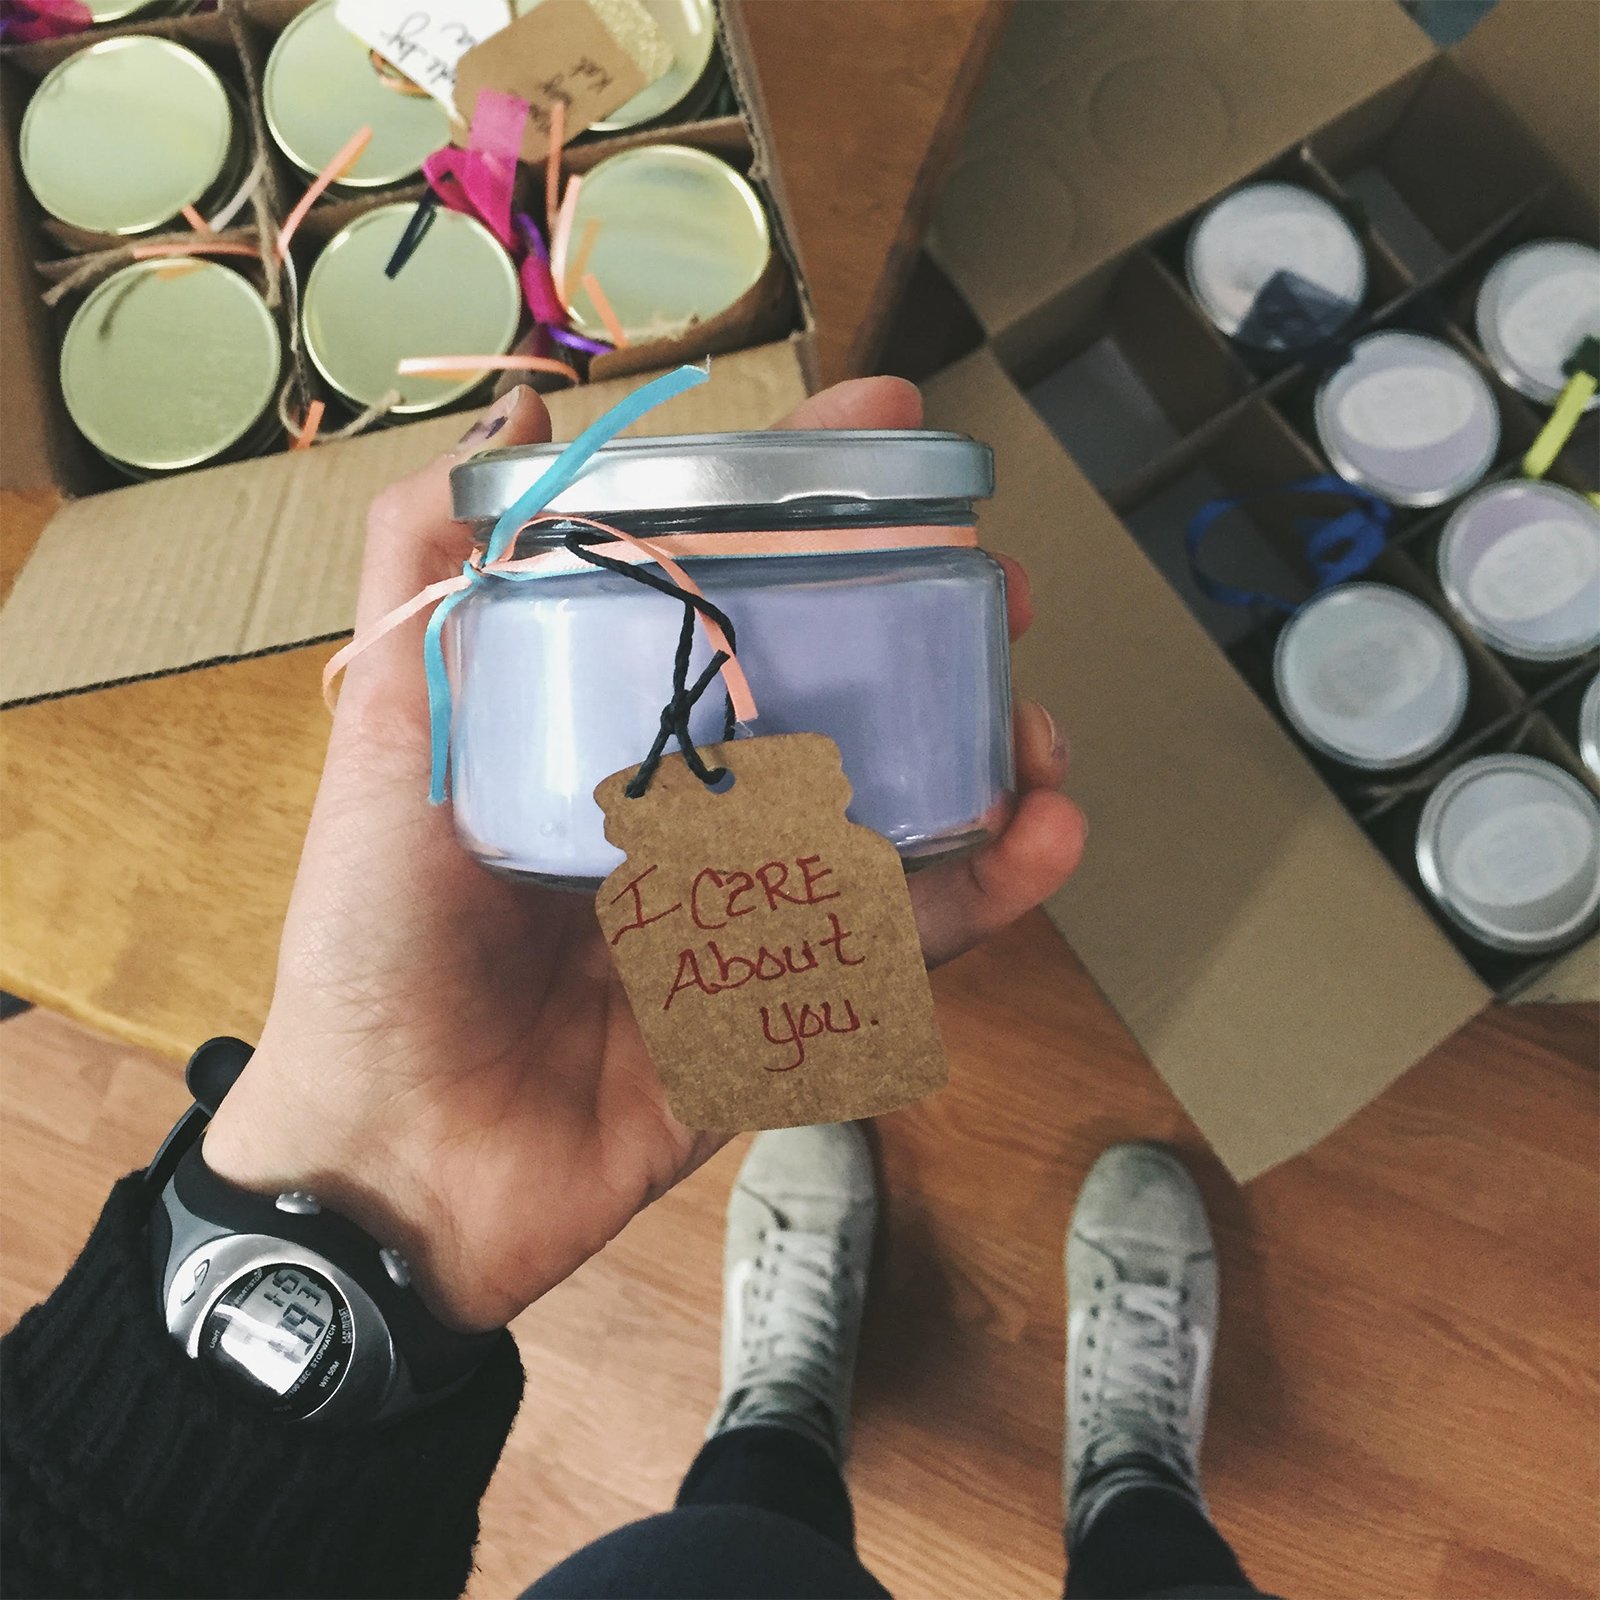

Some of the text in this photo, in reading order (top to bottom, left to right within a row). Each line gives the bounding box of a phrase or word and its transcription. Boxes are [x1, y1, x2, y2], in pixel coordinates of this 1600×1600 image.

[611, 864, 682, 946] I
[663, 912, 866, 1011] About
[759, 999, 879, 1073] you.
[209, 1329, 220, 1349] LIGHT
[298, 1369, 312, 1385] SEC
[310, 1323, 337, 1369] STOPWATCH
[319, 1360, 340, 1388] WR 50M
